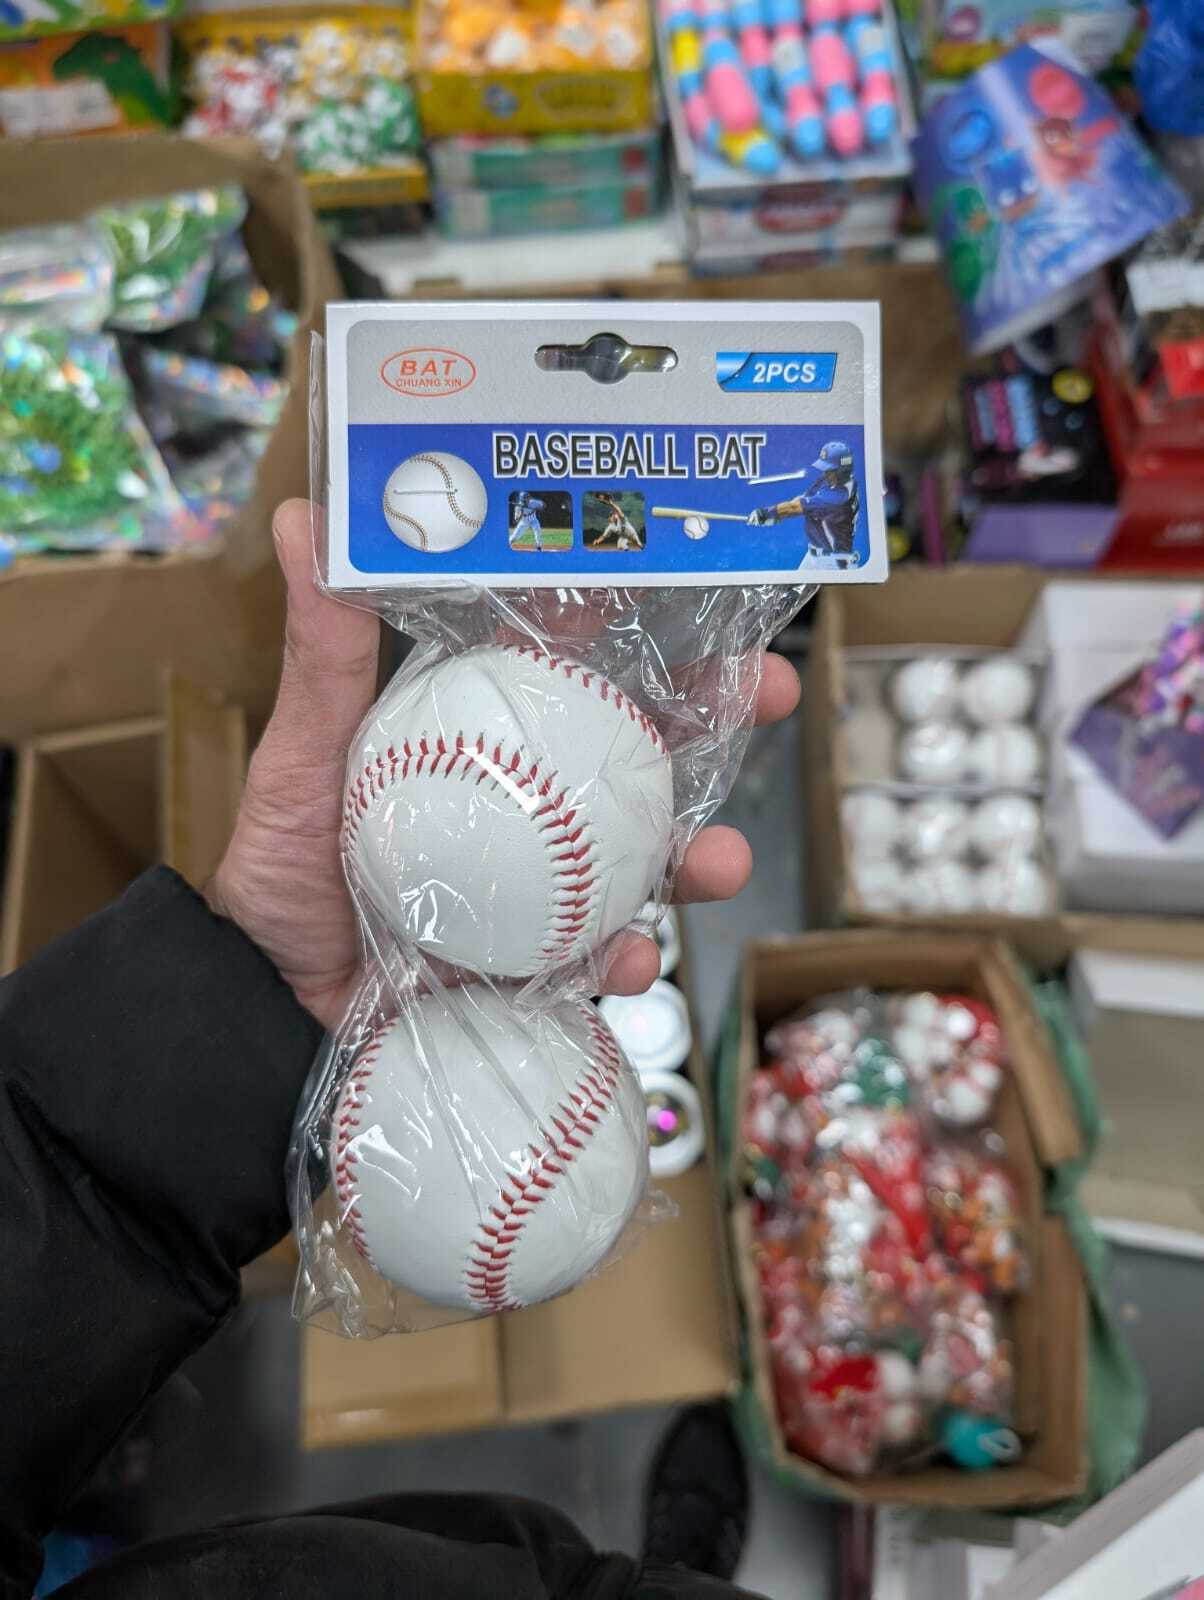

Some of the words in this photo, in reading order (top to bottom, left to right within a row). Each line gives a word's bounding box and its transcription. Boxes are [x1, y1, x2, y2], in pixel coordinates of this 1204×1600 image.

[400, 359, 457, 375] BAT
[752, 363, 816, 383] 2PCS
[395, 378, 441, 388] CHUANG
[443, 378, 462, 388] XIN
[493, 432, 688, 478] BASEBALL
[695, 433, 766, 478] BAT
